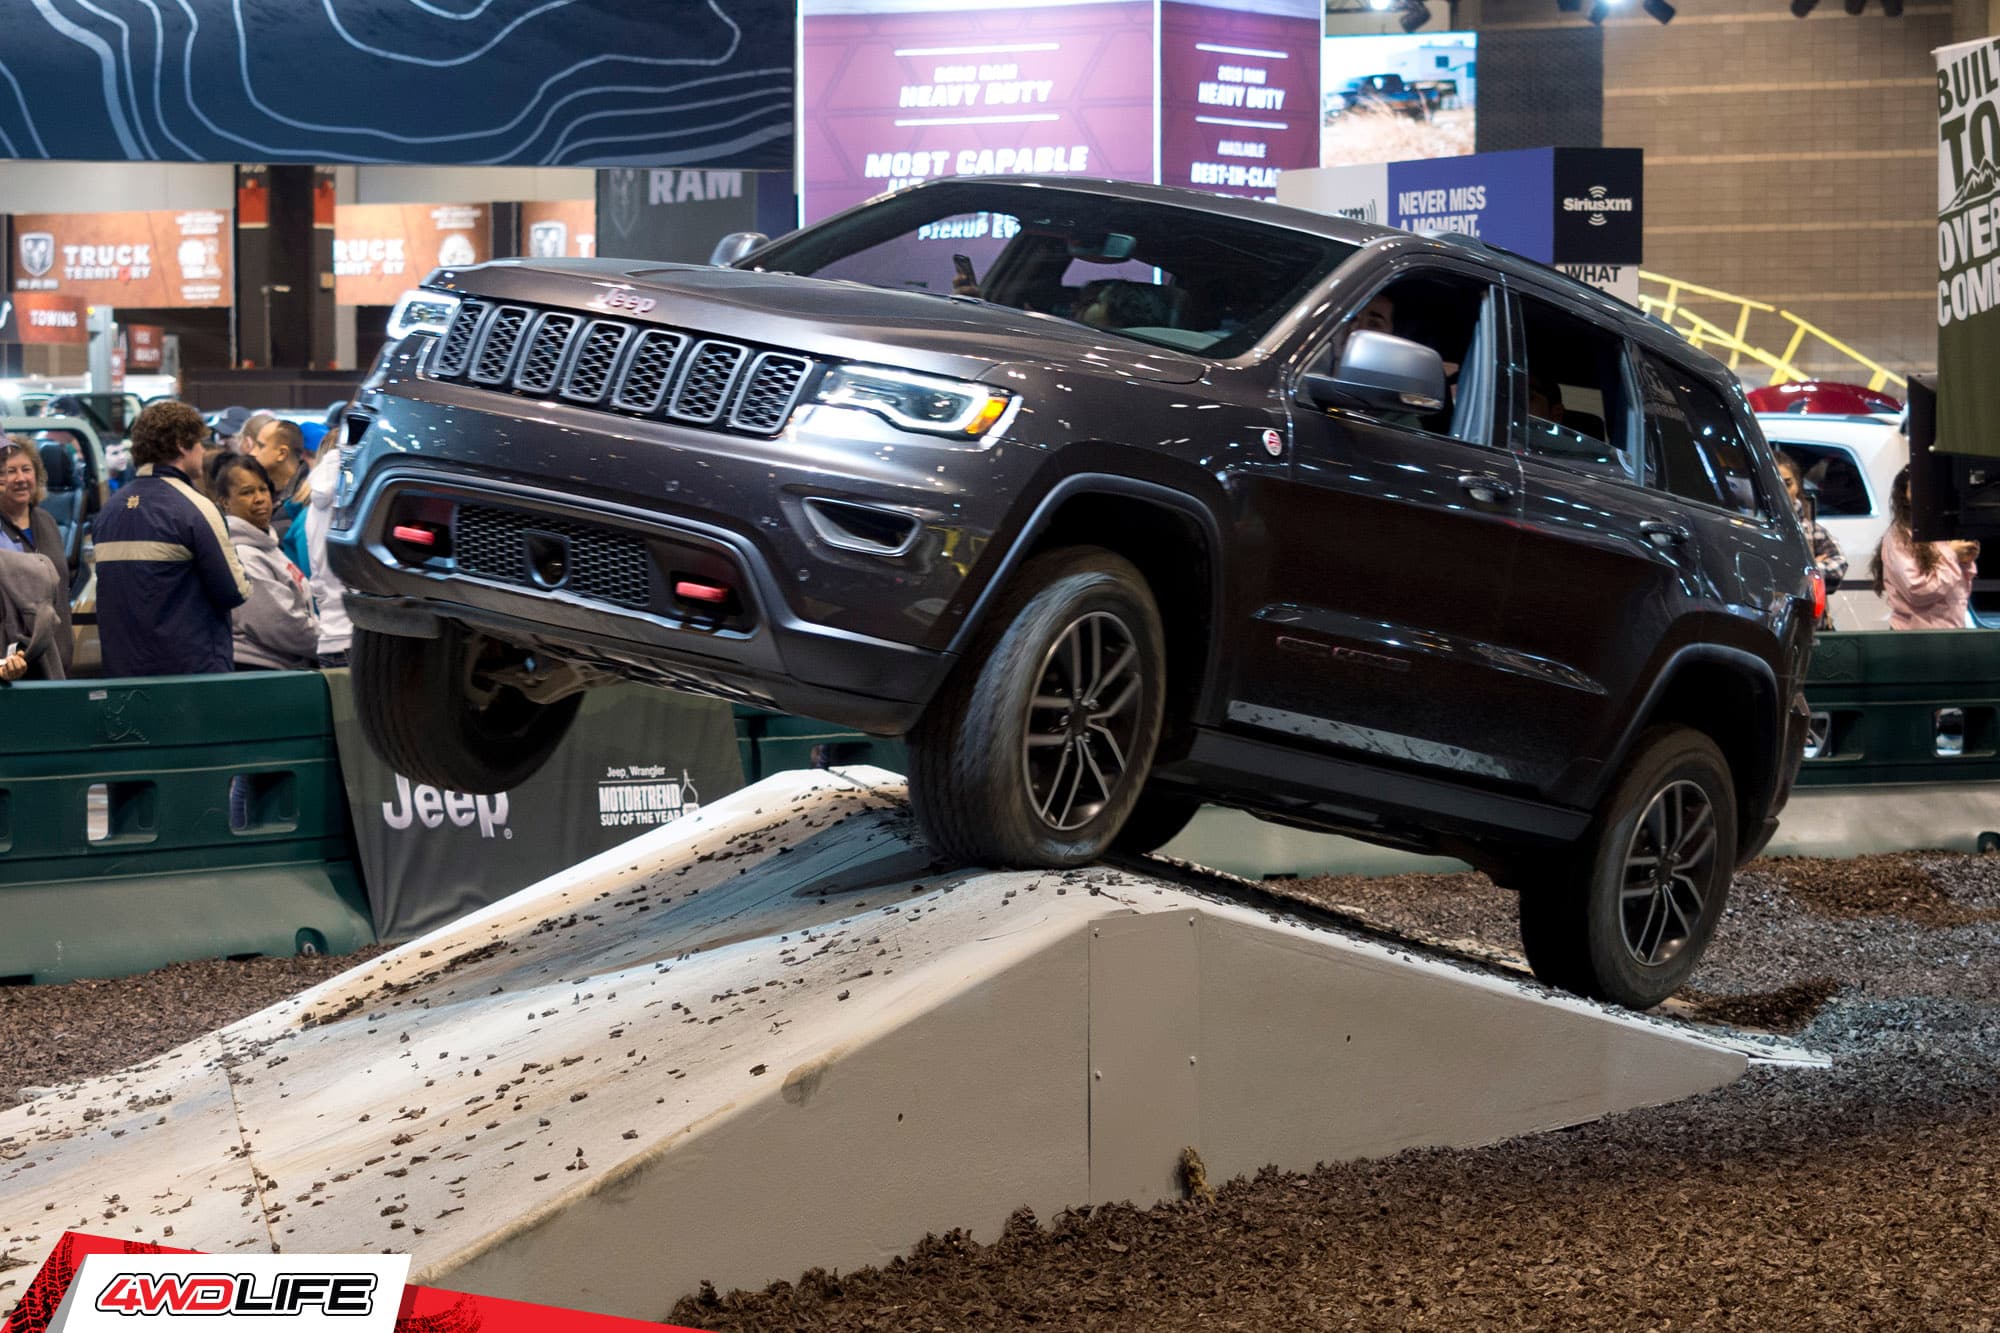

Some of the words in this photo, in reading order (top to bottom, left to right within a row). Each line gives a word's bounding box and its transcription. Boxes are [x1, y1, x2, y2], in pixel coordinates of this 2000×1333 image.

[899, 83, 980, 108] HEAVY
[984, 80, 1053, 105] DUTY
[1197, 81, 1246, 108] HEAVY
[1246, 85, 1286, 110] DUTY
[1941, 99, 2000, 196] TO
[864, 150, 950, 178] MOST
[955, 146, 1090, 175] CAPABLE
[649, 170, 743, 206] RAM
[1398, 189, 1446, 216] NEVER
[1450, 185, 1487, 212] MISS
[917, 218, 989, 241] PICKUP
[1412, 214, 1481, 237] MOMENT.
[63, 244, 151, 266] TRUCK
[334, 239, 404, 262] RUCK
[1564, 264, 1622, 282] WHAT
[594, 288, 657, 316] Jeep
[30, 309, 77, 328] TOWING
[606, 766, 626, 779] Jeep
[628, 764, 666, 778] Wrangler
[382, 772, 509, 839] Jeep
[599, 783, 681, 812] MOTORTREND
[600, 812, 619, 827] SUV
[620, 813, 634, 825] OF
[635, 811, 655, 824] THE
